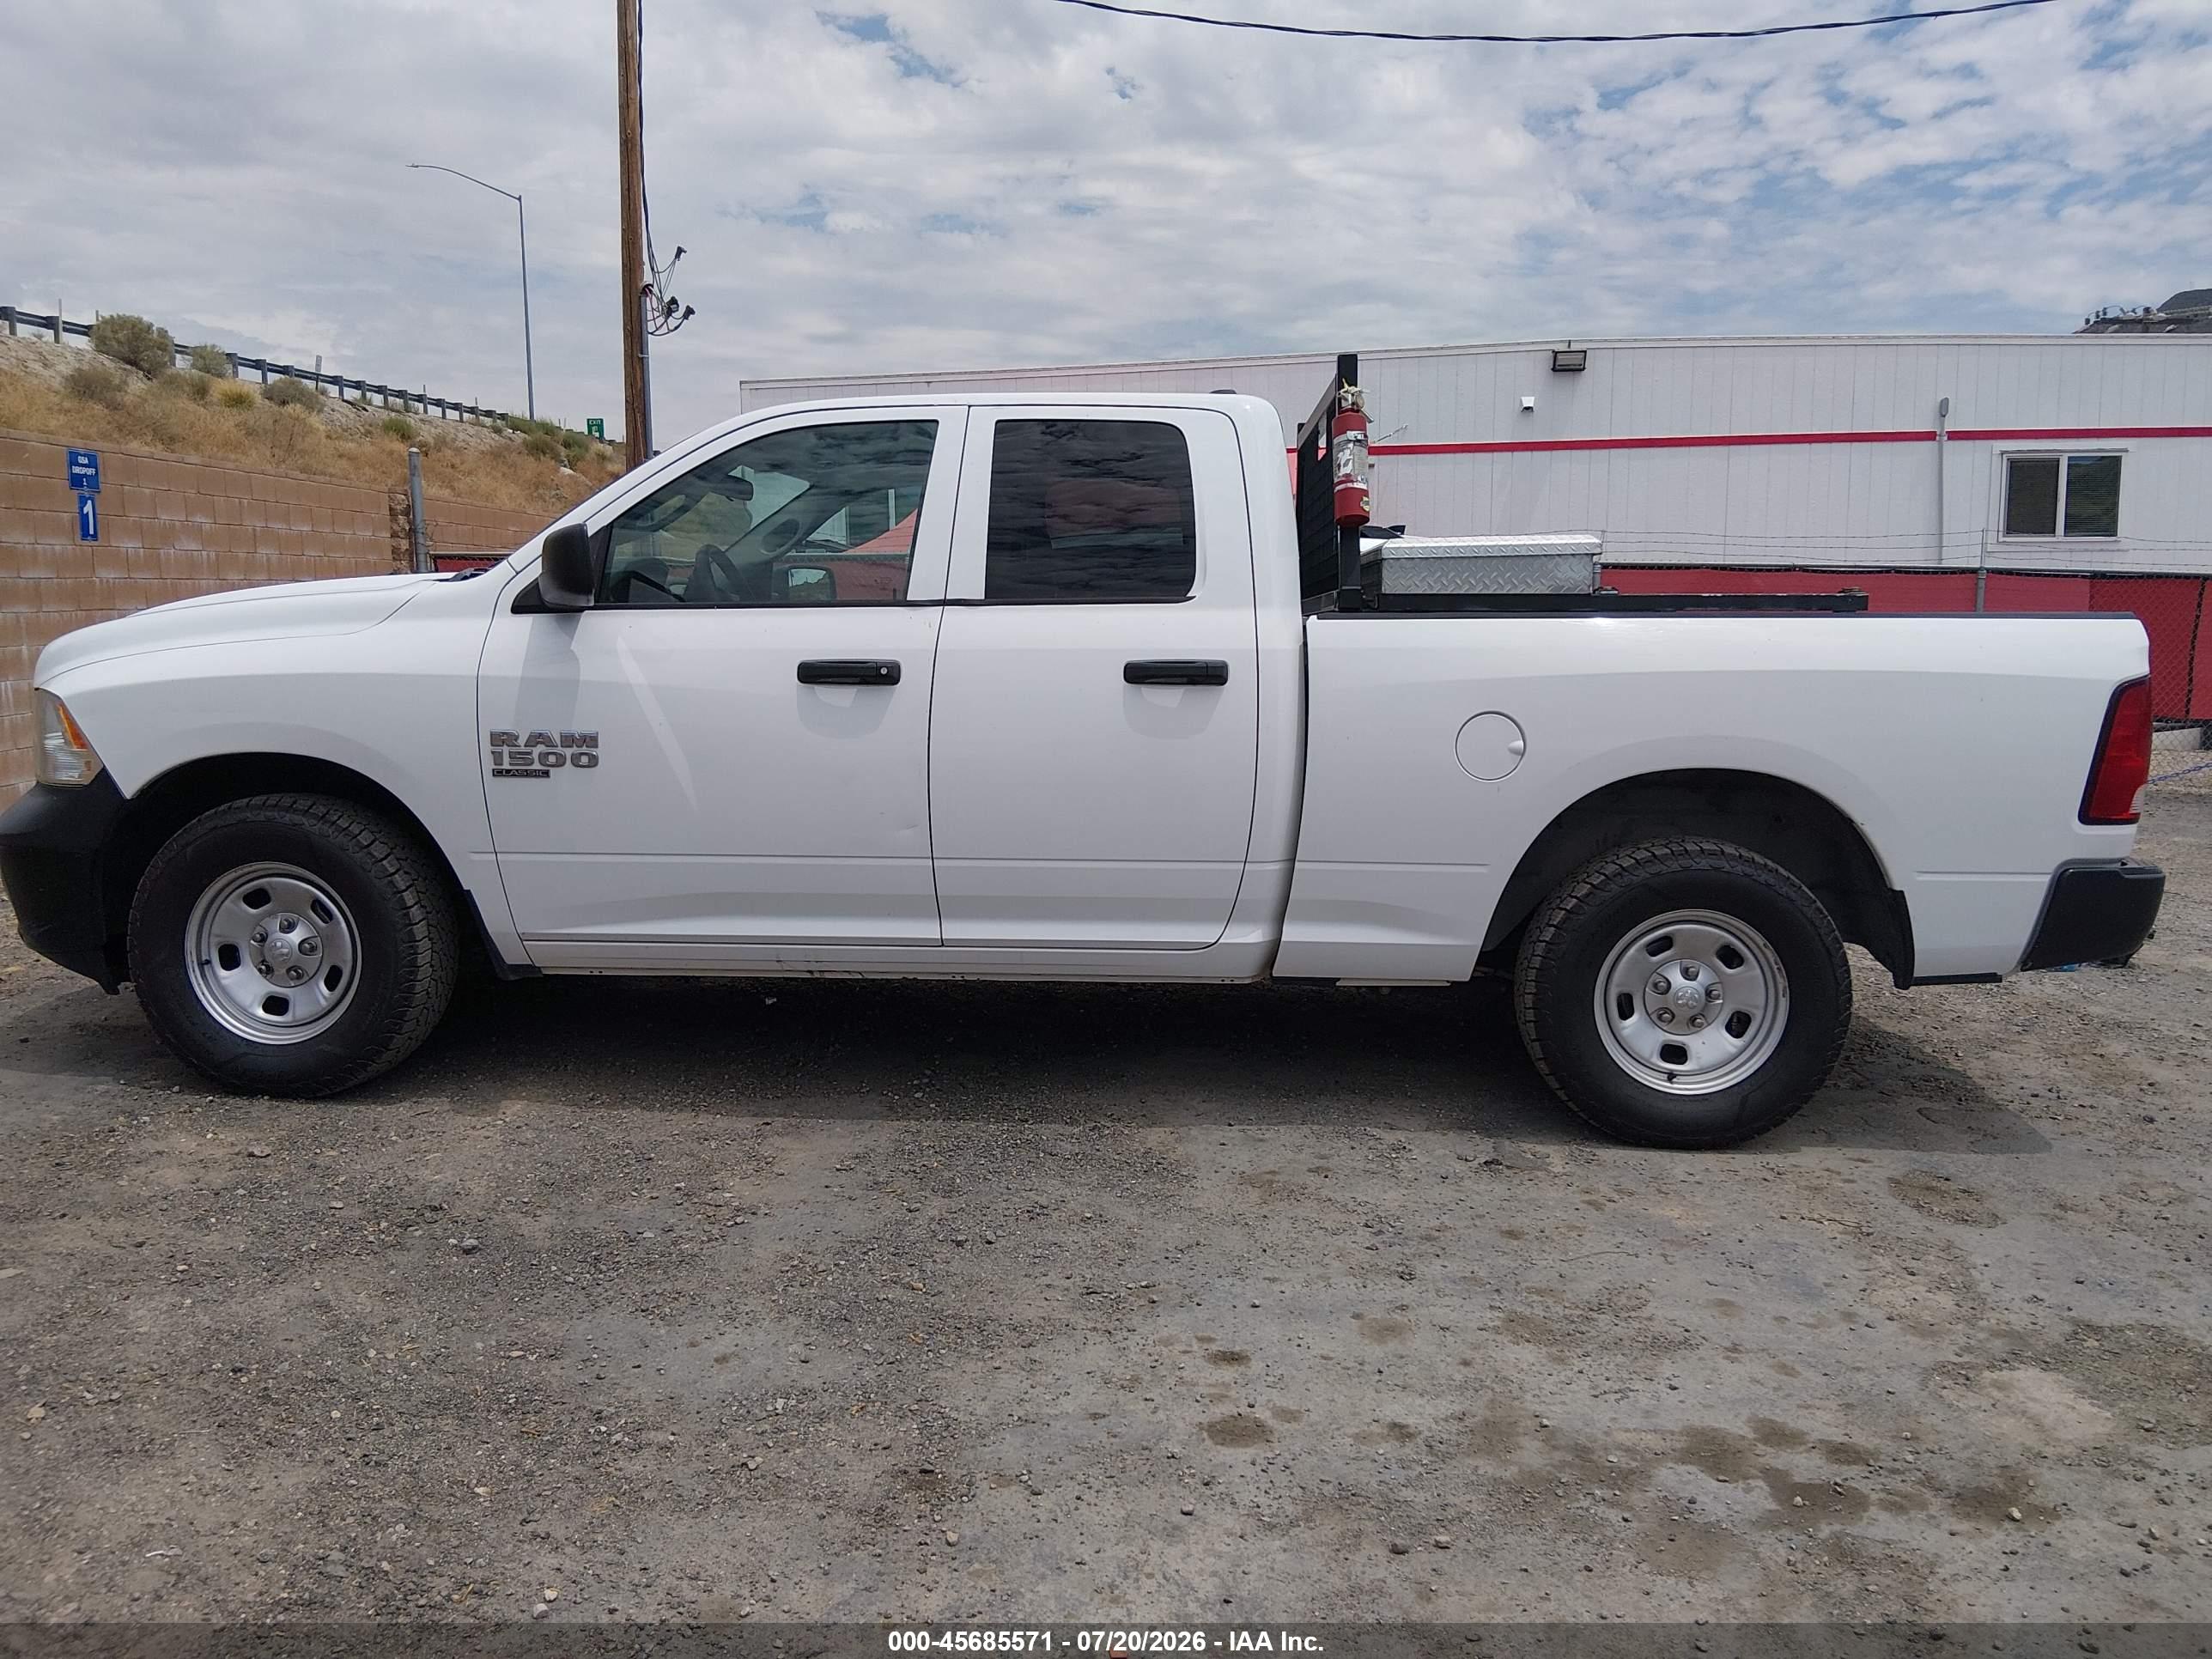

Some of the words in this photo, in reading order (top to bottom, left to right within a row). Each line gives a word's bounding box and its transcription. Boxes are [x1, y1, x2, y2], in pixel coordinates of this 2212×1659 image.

[71, 465, 96, 476] DROPOFF
[83, 500, 94, 535] 1
[489, 729, 599, 749] RAM
[490, 749, 599, 769] 1500
